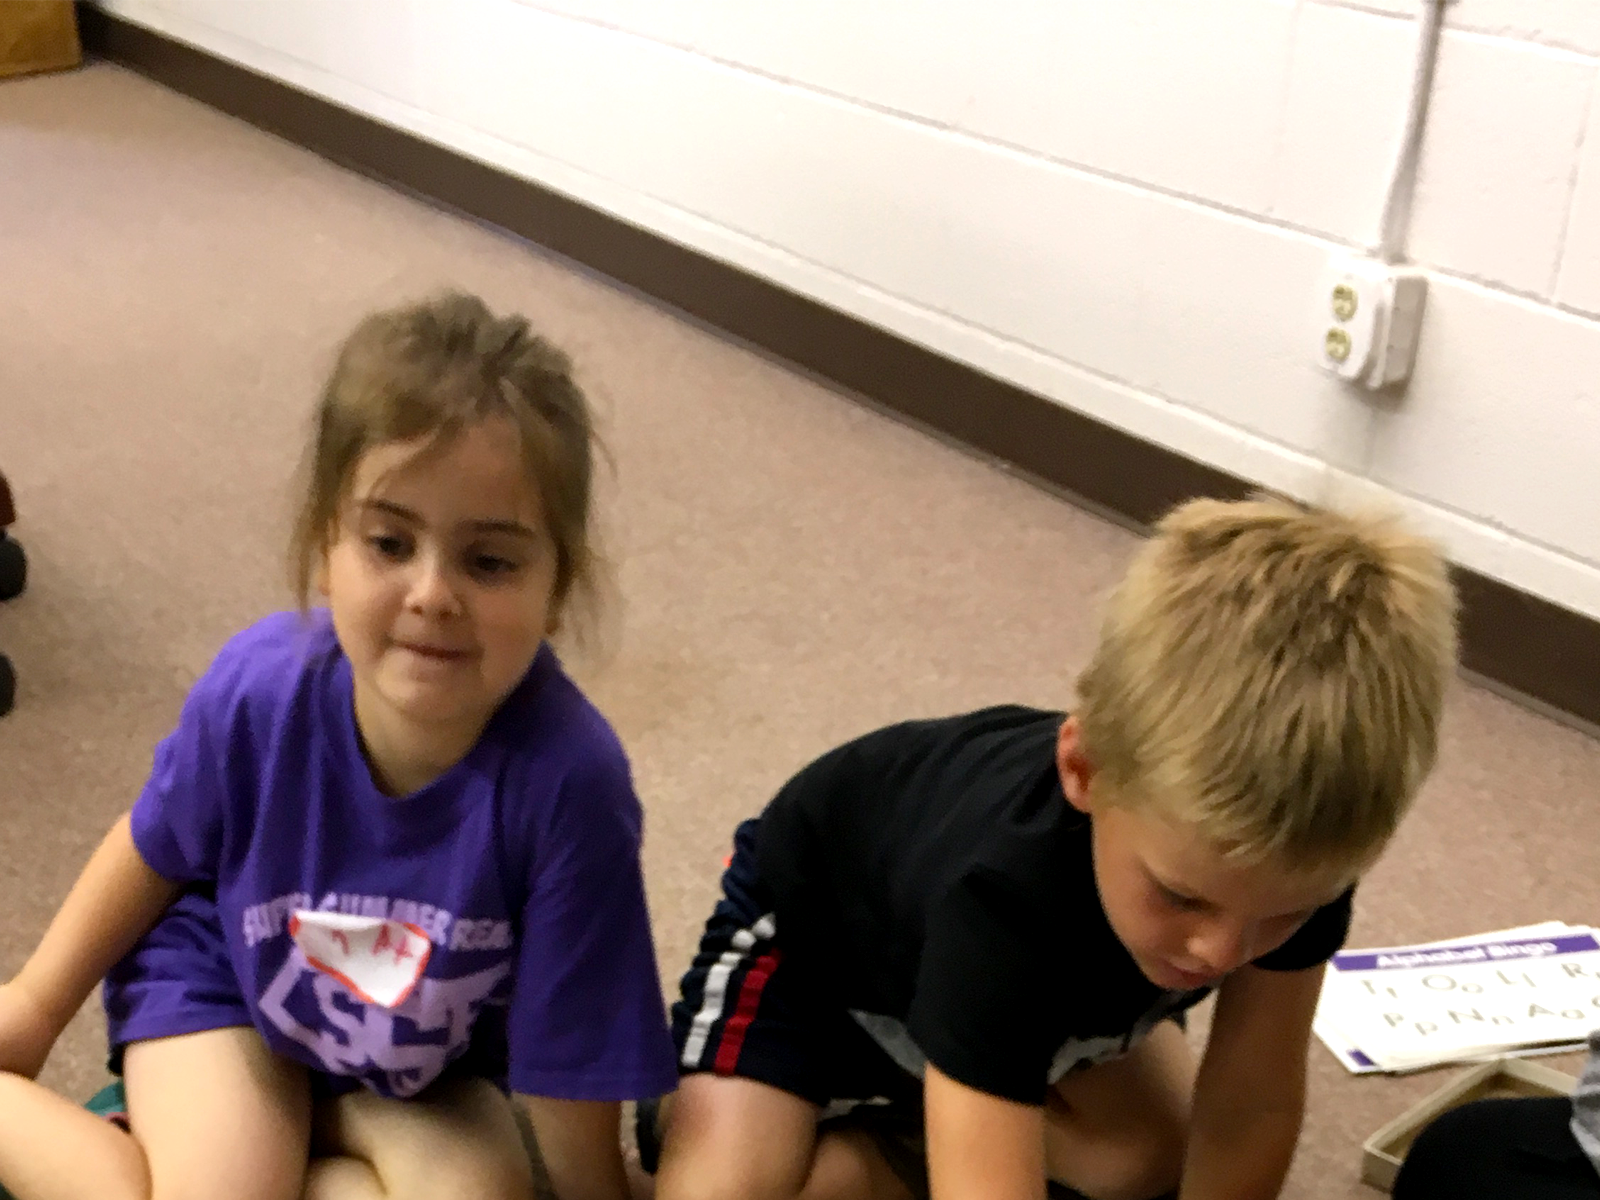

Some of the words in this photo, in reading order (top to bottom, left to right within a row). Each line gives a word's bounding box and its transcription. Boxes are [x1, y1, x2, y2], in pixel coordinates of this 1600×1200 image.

[1376, 949, 1485, 969] Alphabet
[1488, 941, 1557, 960] Bingo
[1447, 1008, 1514, 1026] Nn
